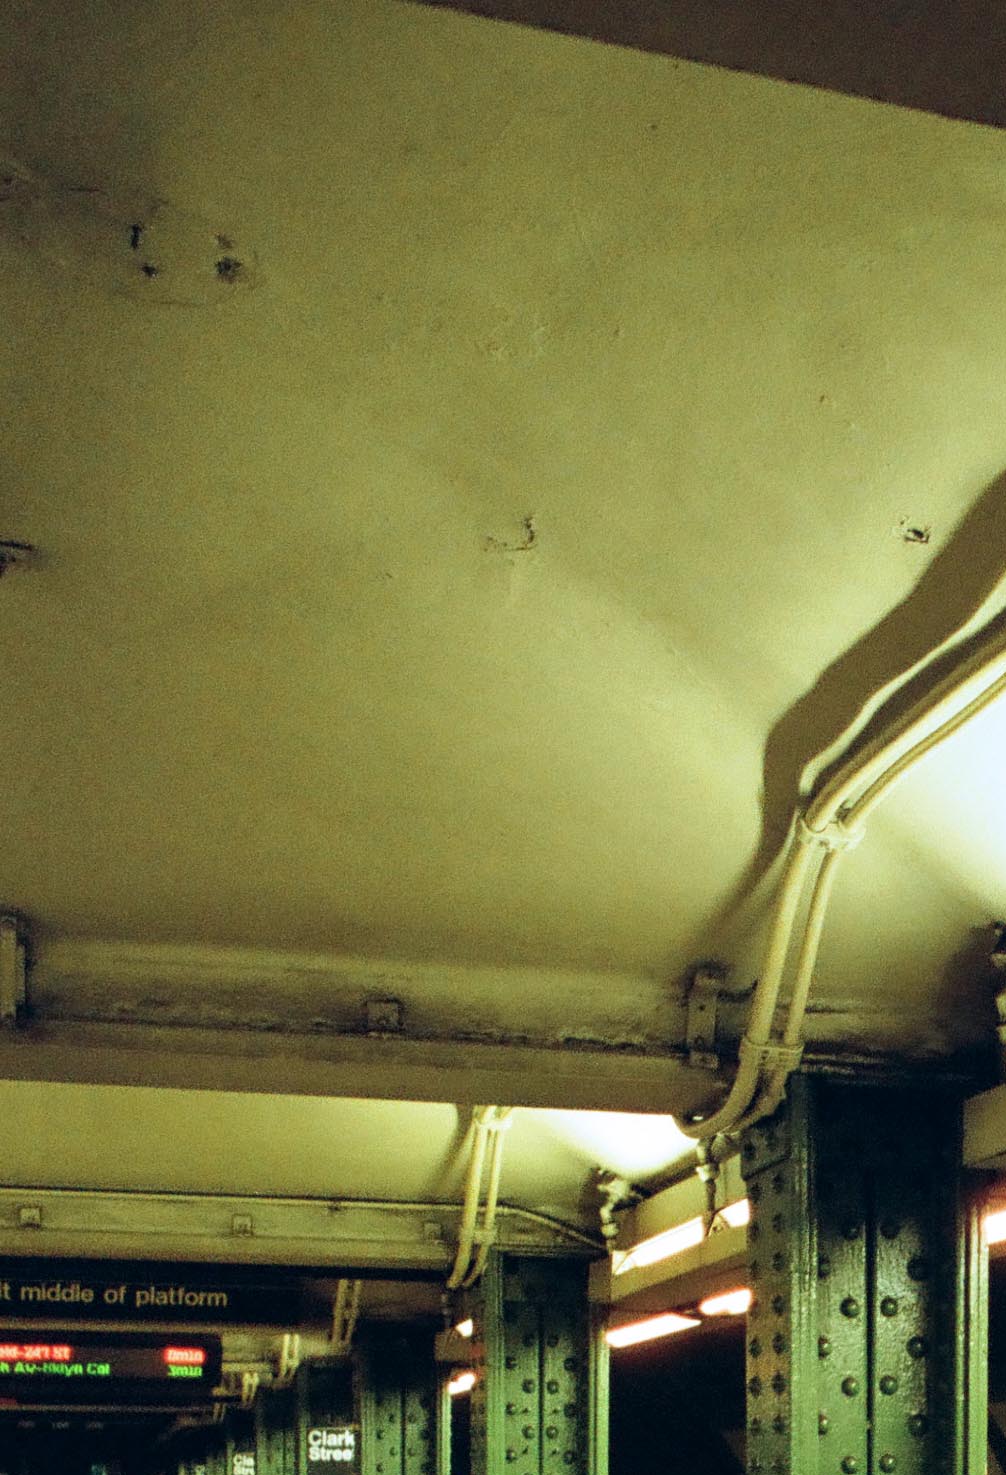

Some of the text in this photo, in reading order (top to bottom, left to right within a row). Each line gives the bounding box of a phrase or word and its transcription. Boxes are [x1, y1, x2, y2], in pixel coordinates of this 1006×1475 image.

[20, 1281, 95, 1304] middle
[104, 1284, 128, 1305] of
[136, 1285, 229, 1308] platform
[308, 1429, 355, 1446] Clark
[308, 1445, 354, 1462] Stree
